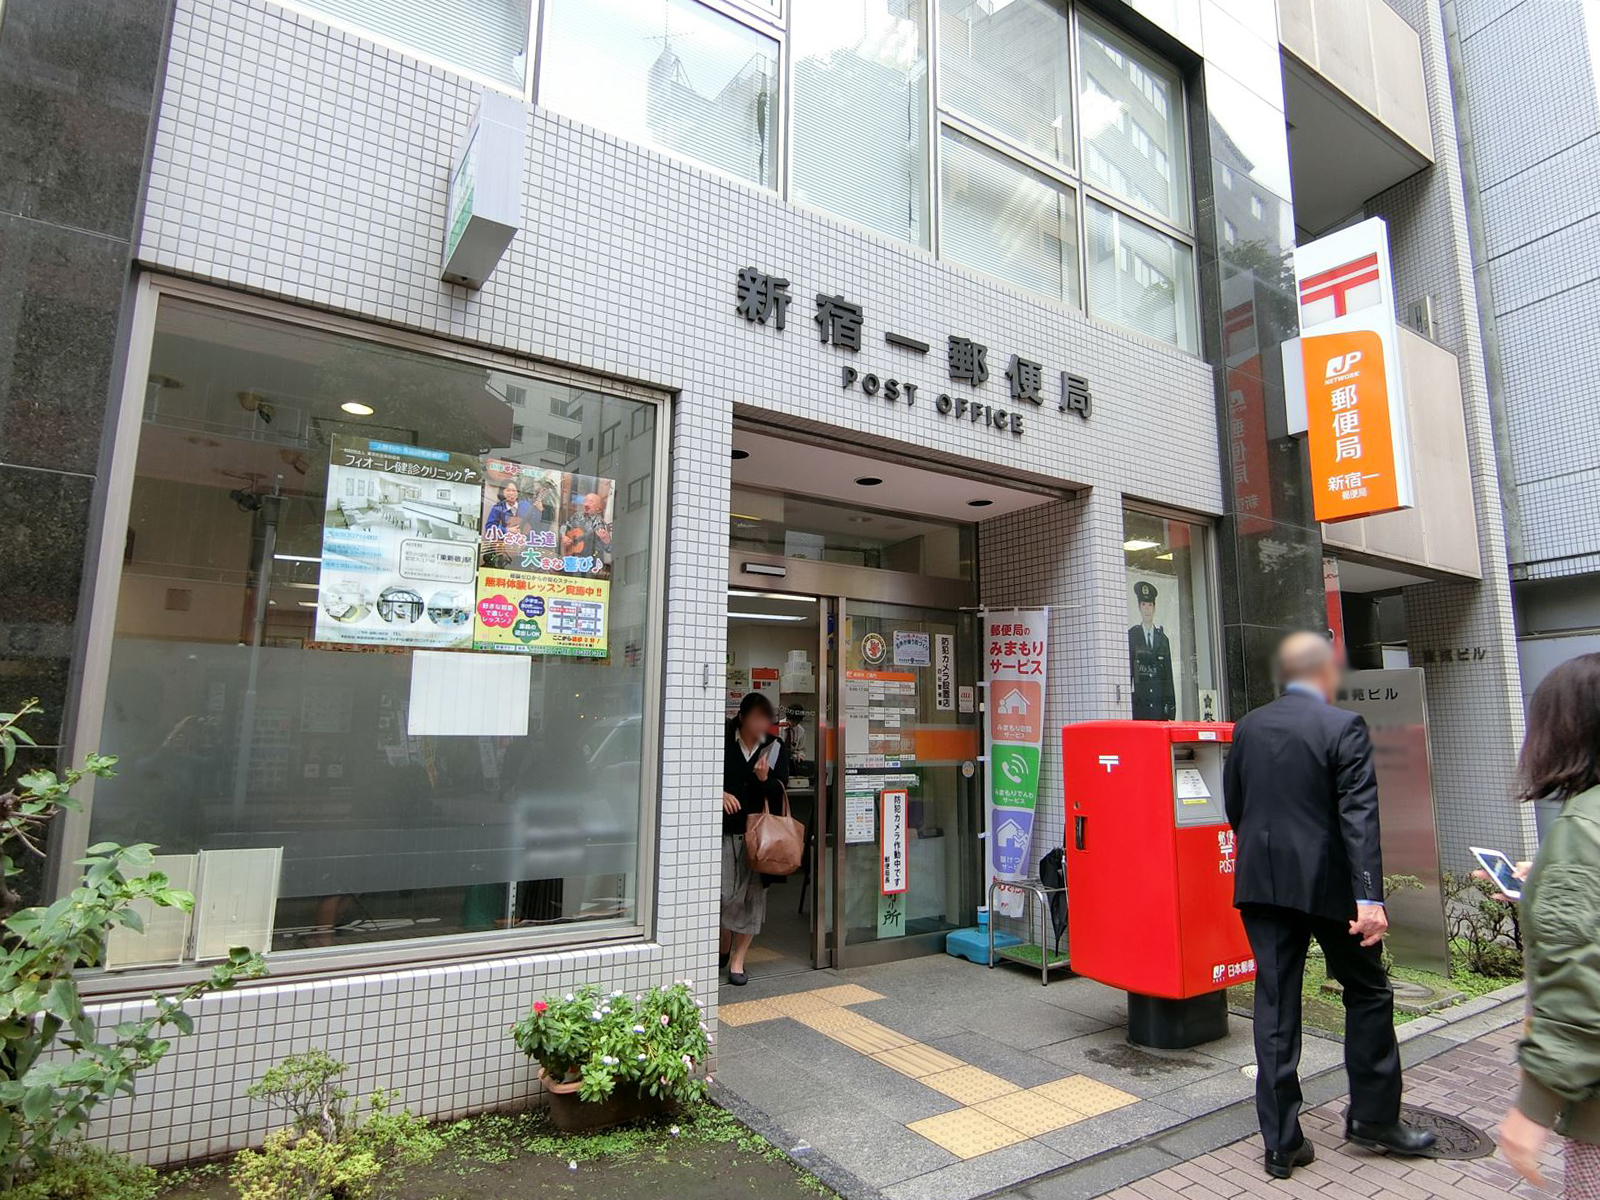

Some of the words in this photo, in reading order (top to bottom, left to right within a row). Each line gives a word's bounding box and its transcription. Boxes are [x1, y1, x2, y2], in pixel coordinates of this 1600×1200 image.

[737, 266, 1092, 419] 新宿一郵便局
[1324, 371, 1360, 386] NETWORK
[842, 366, 918, 406] POST
[936, 393, 1024, 435] OFFICE
[1330, 384, 1362, 463] 郵便局
[345, 455, 464, 482] フィオーレ健診クリニック
[1327, 471, 1380, 492] 新宿一
[1341, 487, 1368, 500] 郵便局
[486, 525, 556, 547] 小さな上達
[990, 624, 1030, 636] 郵便局の
[989, 640, 1044, 657] みまもり
[941, 637, 950, 708] 防犯カメラ設置店
[990, 658, 1043, 675] サービス
[1217, 830, 1235, 847] 郵便
[1219, 859, 1235, 874] POST
[1227, 959, 1255, 978] 日本郵便
